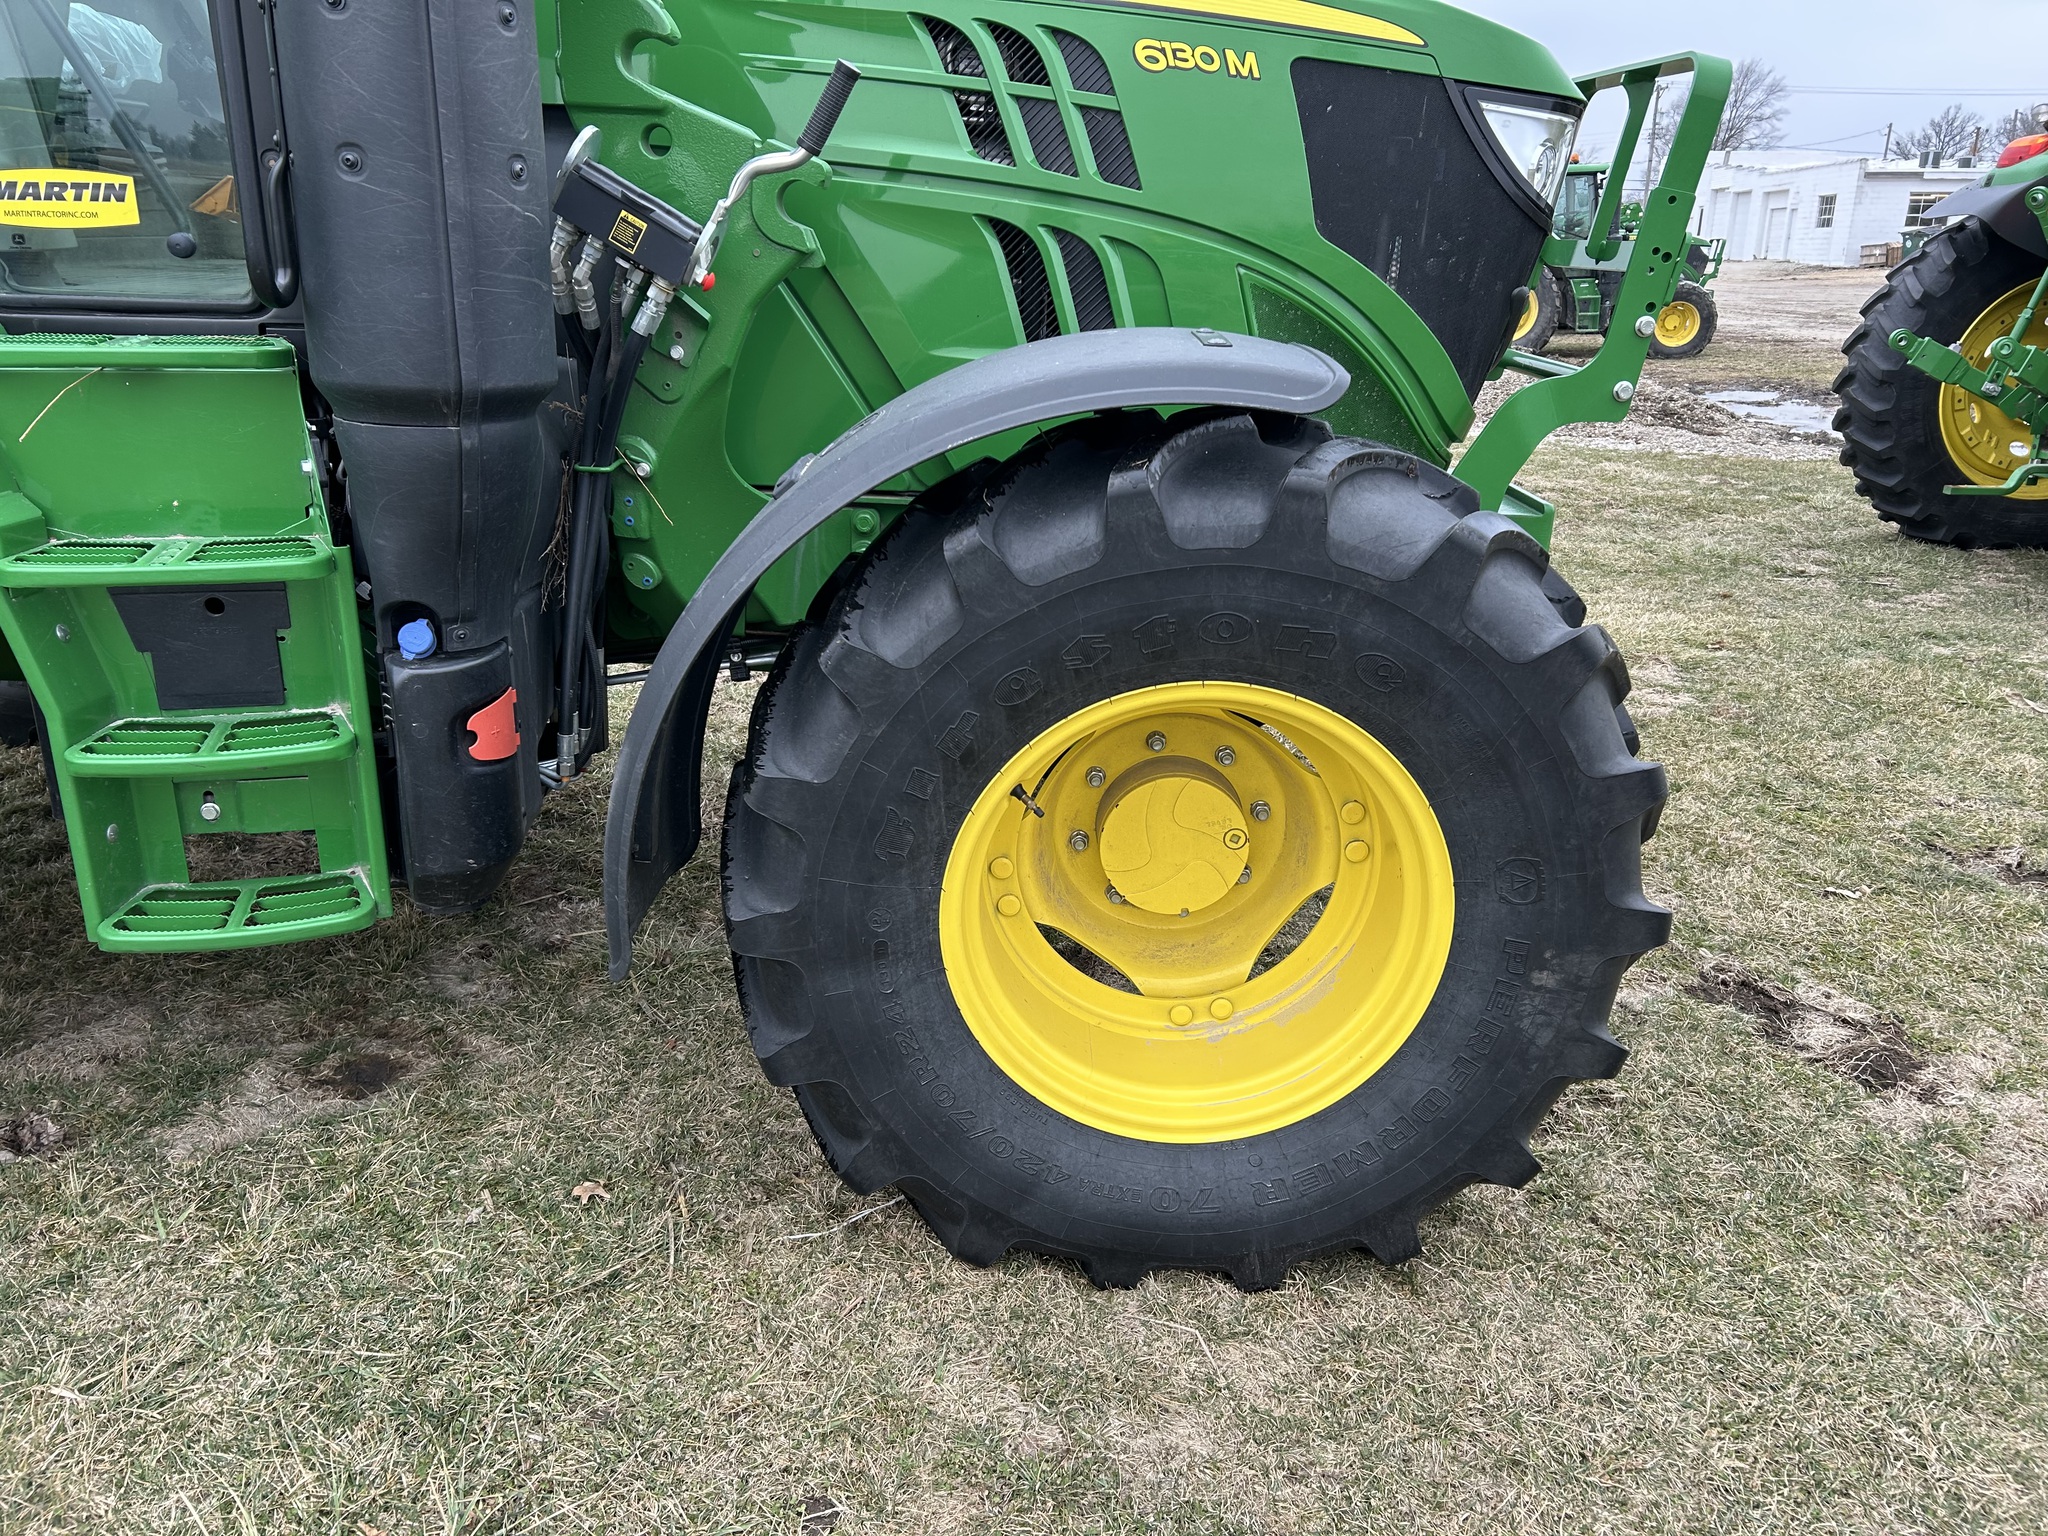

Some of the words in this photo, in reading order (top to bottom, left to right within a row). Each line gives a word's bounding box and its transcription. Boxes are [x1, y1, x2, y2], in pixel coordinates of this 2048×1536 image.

[1133, 38, 1221, 73] 6130
[1224, 48, 1261, 80] M
[0, 181, 128, 203] MARTIN
[4, 210, 99, 219] MARTINTRACTORINC.COM
[1254, 937, 1533, 1207] PERFORMER
[882, 1001, 1073, 1186] 420/70R24
[1077, 1175, 1145, 1205] EXTRA
[1147, 1184, 1221, 1215] 70
